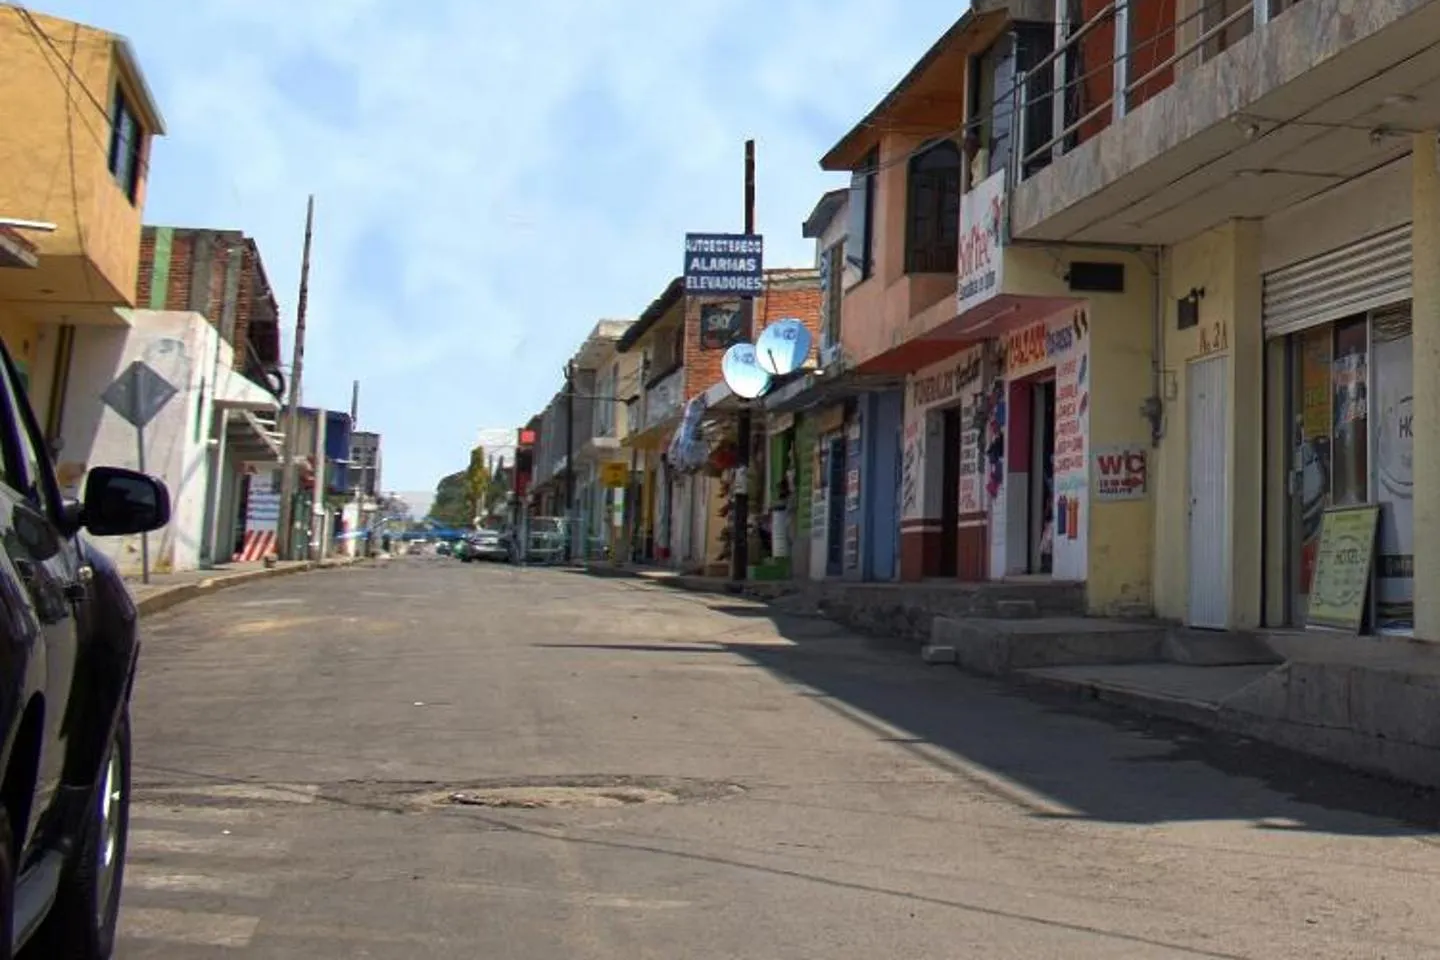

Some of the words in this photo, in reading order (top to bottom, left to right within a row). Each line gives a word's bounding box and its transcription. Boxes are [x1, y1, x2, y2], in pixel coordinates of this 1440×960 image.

[690, 257, 756, 271] ALARMAS
[686, 275, 762, 290] ELEVADORES
[1098, 453, 1146, 474] WC
